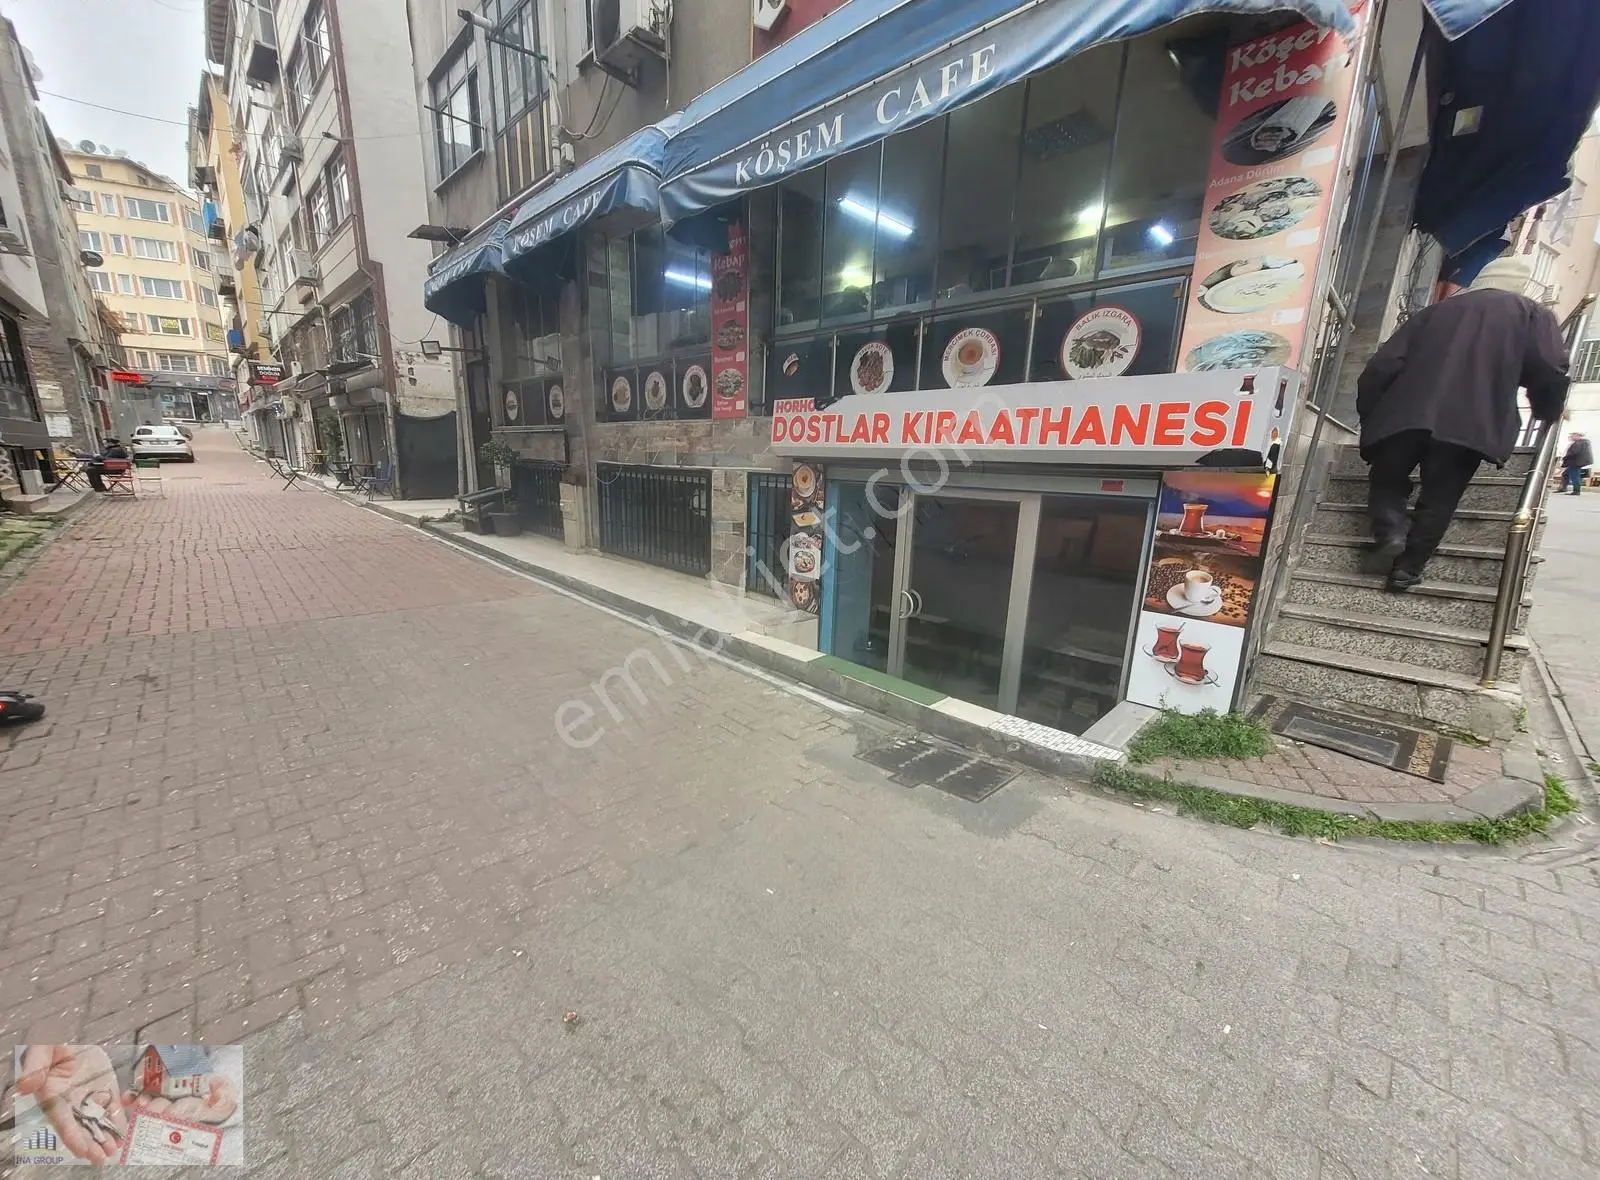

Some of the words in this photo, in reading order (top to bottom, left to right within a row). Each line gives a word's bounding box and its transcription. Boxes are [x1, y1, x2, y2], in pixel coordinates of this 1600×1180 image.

[876, 43, 996, 125] CAFE
[1229, 53, 1350, 107] Kebap
[1209, 174, 1244, 188] Adana
[563, 190, 601, 226] CAFE
[1075, 312, 1100, 331] BALIK
[771, 412, 890, 446] DOSTLAR
[900, 399, 1254, 448] KIRAATHANESİ
